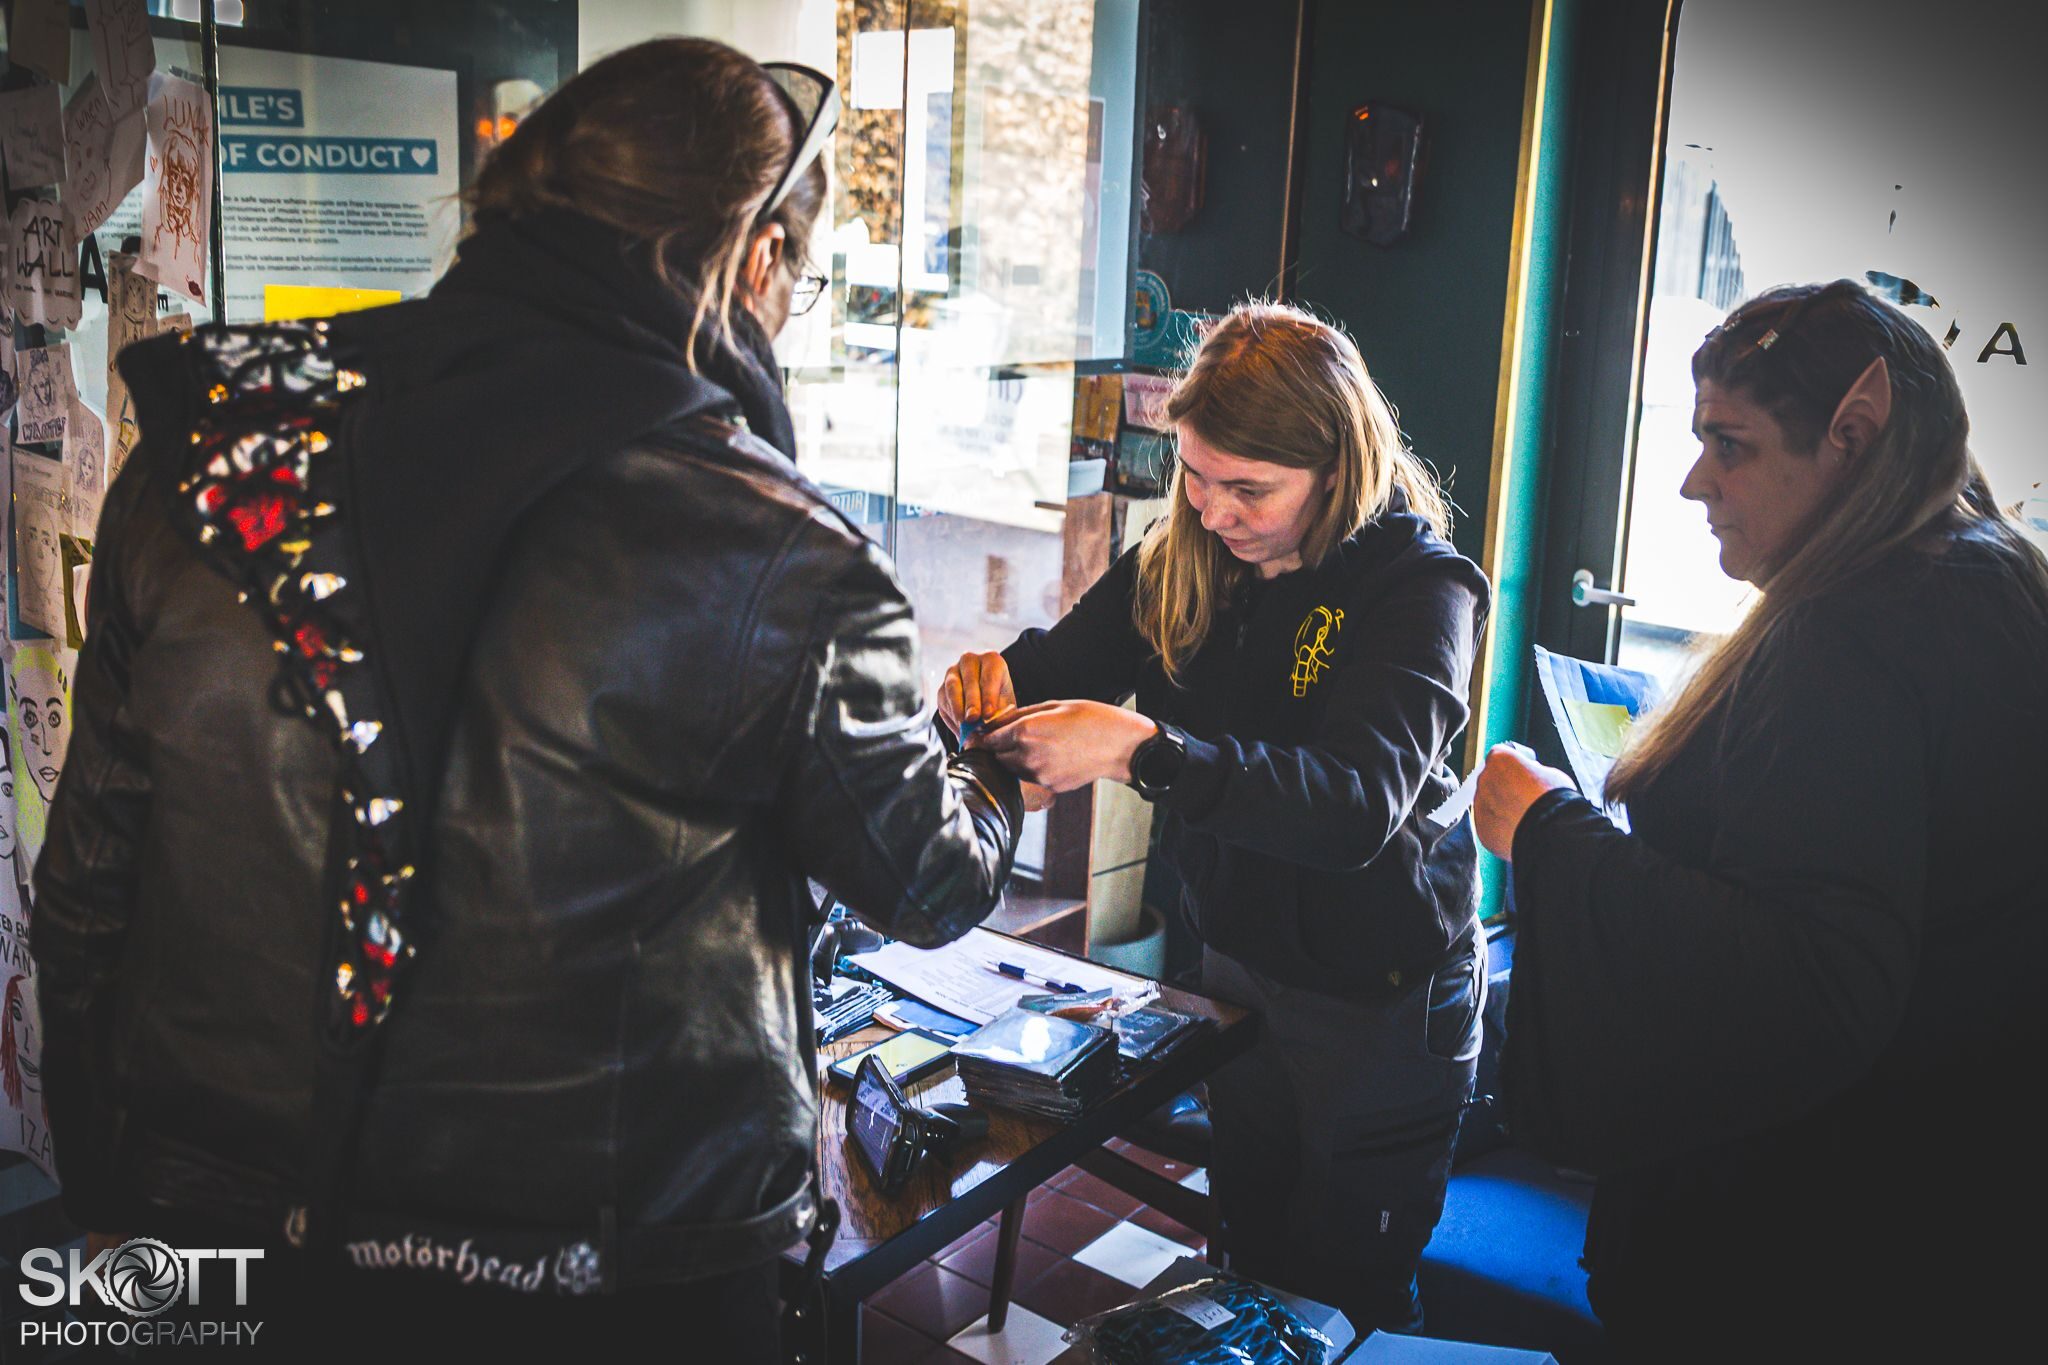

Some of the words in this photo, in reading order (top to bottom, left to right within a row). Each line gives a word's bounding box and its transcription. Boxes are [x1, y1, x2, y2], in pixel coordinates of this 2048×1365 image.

[221, 142, 247, 167] F
[256, 143, 404, 169] CONDUCT
[22, 215, 63, 248] ART
[16, 247, 74, 278] WALL
[0, 913, 13, 932] ED
